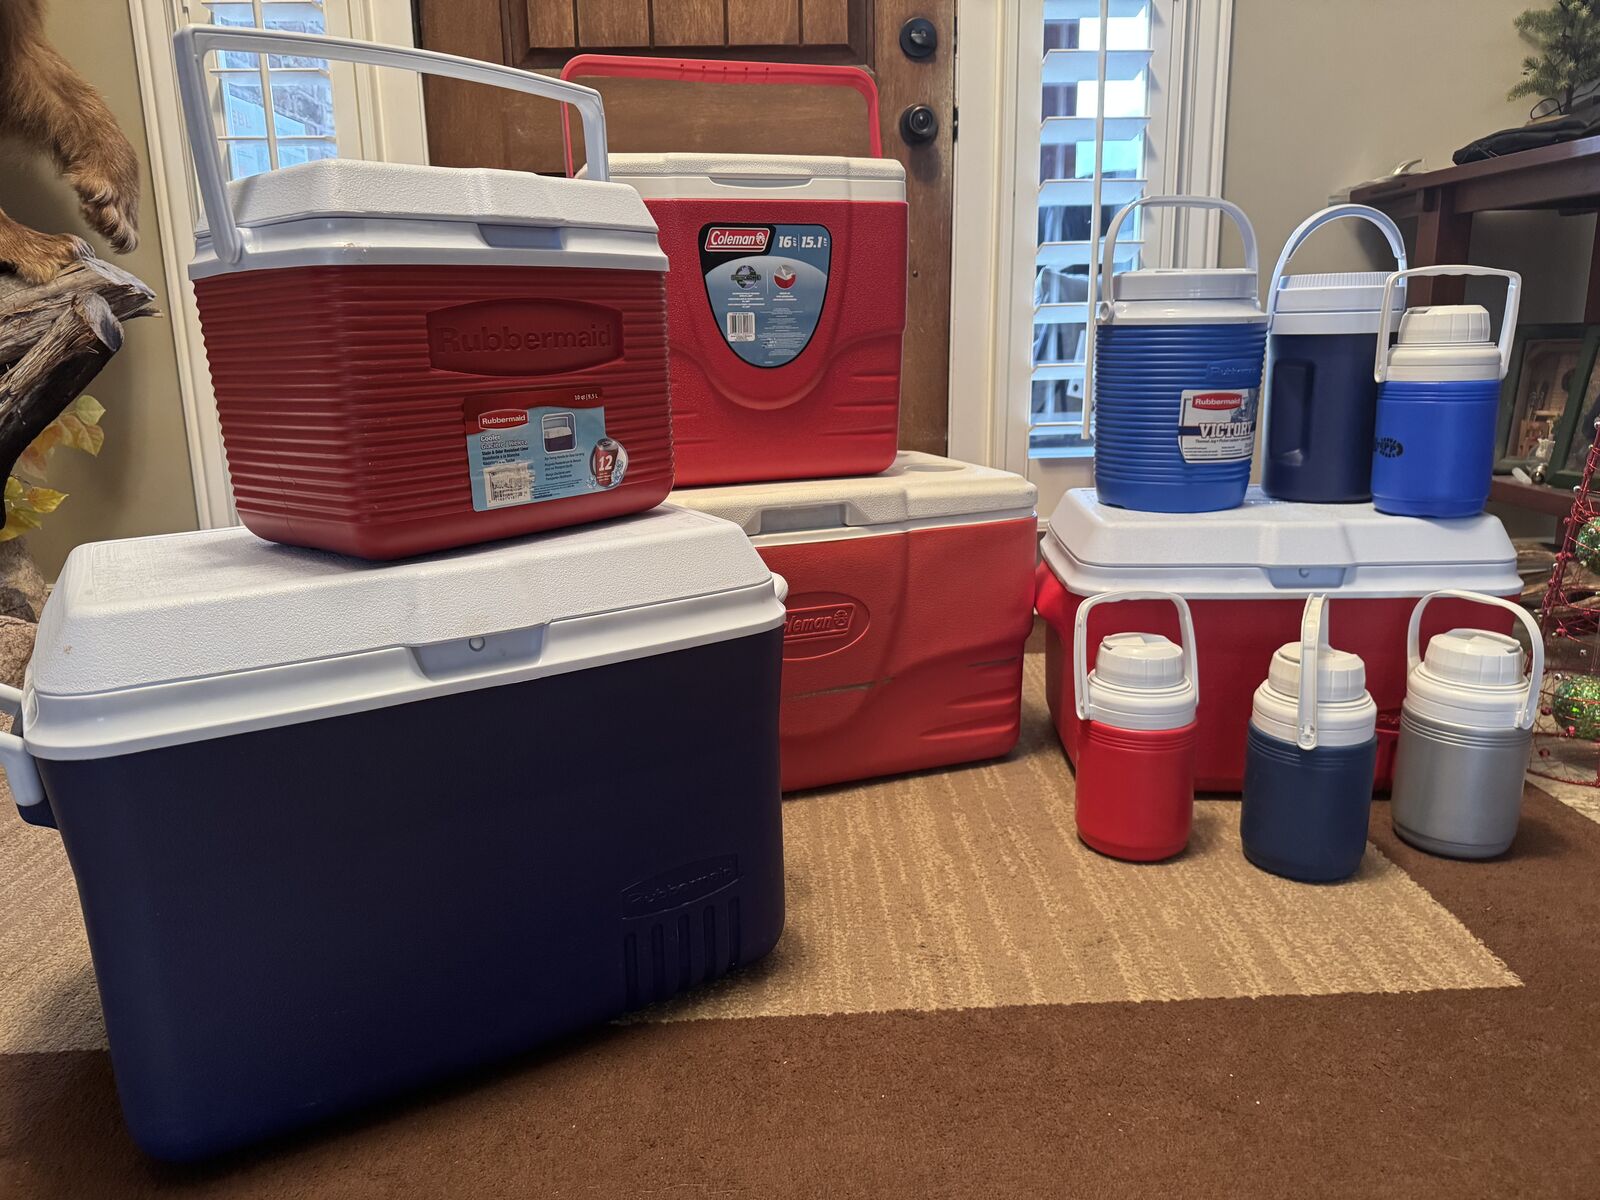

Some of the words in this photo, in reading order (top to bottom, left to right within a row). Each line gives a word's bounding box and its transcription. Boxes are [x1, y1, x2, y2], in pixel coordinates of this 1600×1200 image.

[711, 230, 755, 245] Coleman
[778, 236, 792, 248] 16
[801, 236, 823, 248] 15.1
[436, 323, 612, 353] Rubbermaid
[1195, 397, 1241, 407] Rubbermaid
[482, 413, 526, 425] Rubbermaid
[1199, 421, 1252, 439] VICTORY
[480, 434, 501, 442] Cooler
[598, 455, 613, 472] 12
[784, 614, 833, 633] oleman
